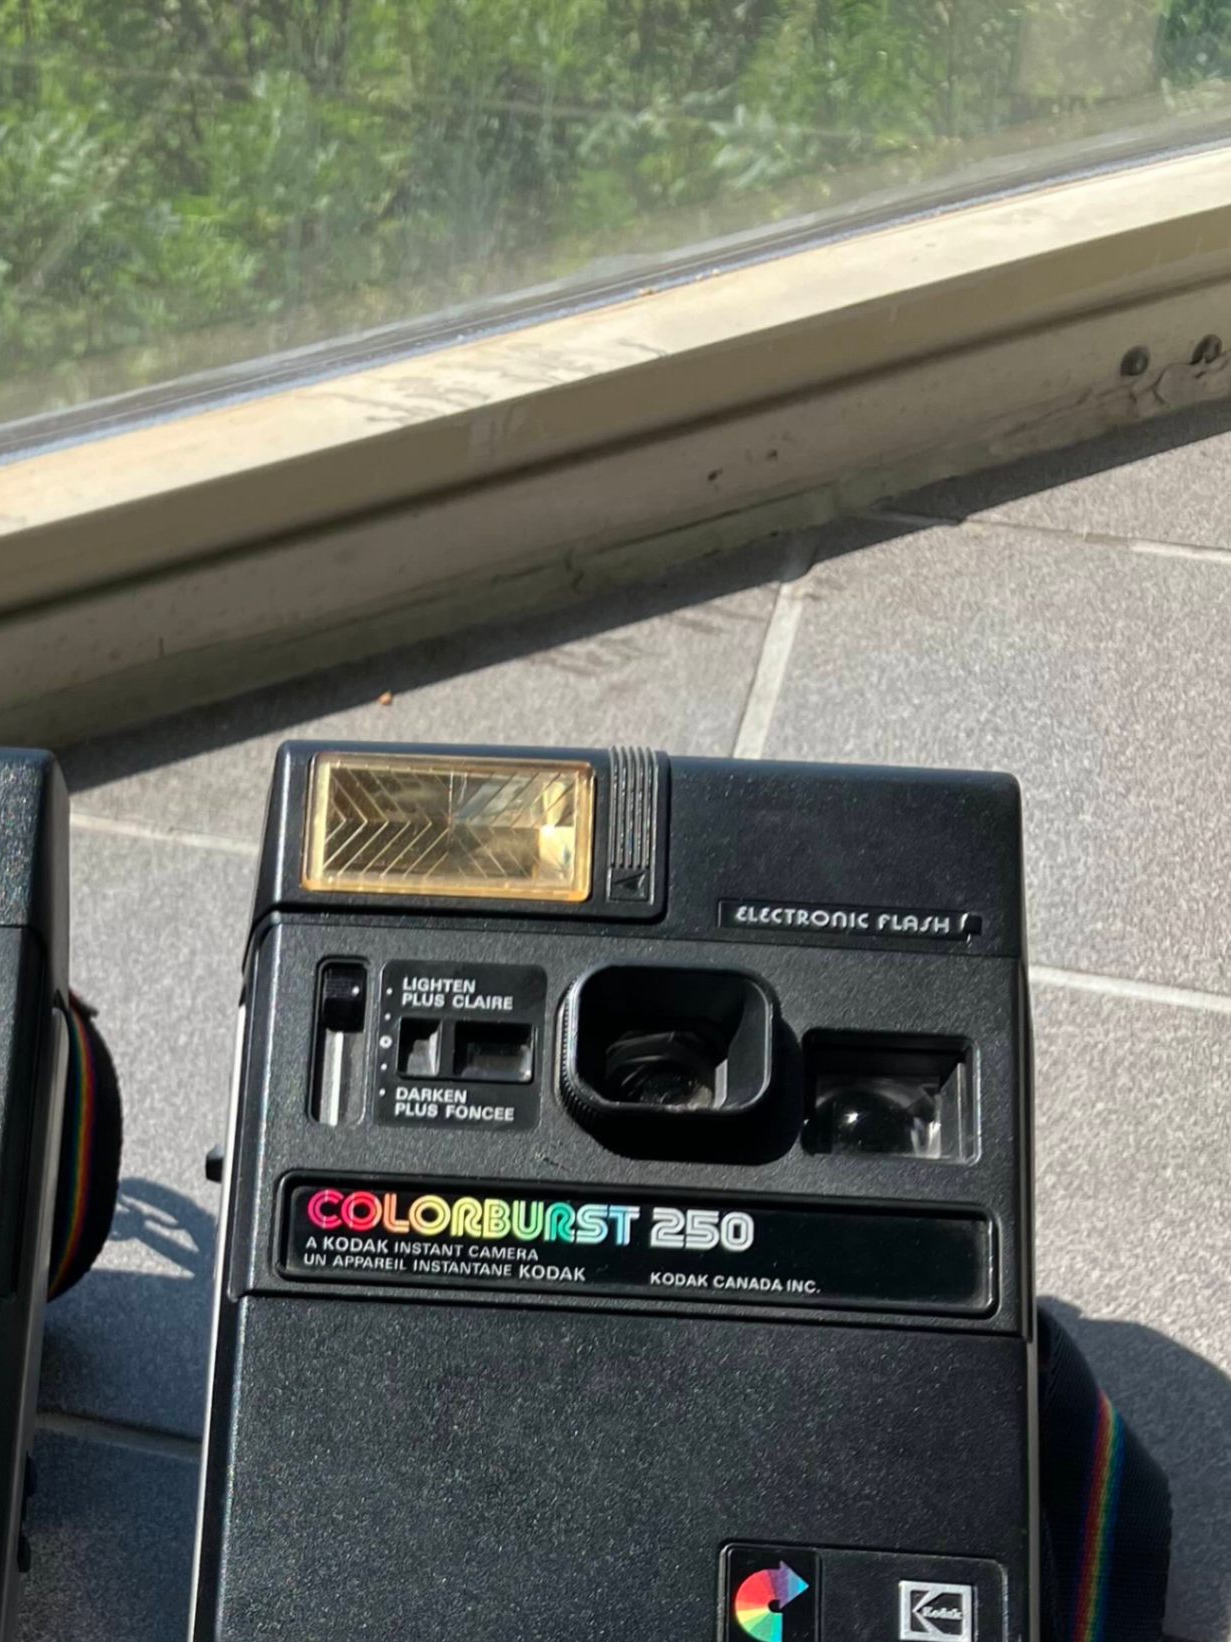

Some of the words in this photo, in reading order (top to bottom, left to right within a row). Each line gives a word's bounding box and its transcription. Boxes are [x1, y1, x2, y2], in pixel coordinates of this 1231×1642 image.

[735, 906, 869, 929] ELECTRONIC
[878, 913, 950, 933] FLASH
[402, 977, 476, 994] LIGHTEN
[401, 992, 445, 1008] PLUS
[452, 995, 514, 1011] CLAIRE
[395, 1086, 468, 1104] DARKEN
[394, 1102, 438, 1118] PLUS
[445, 1105, 515, 1121] FONCEE
[307, 1189, 641, 1246] COLORBURST
[649, 1206, 755, 1252] 250
[305, 1236, 317, 1249] A
[323, 1235, 389, 1254] KODAK
[394, 1241, 464, 1258] INSTANT
[468, 1245, 539, 1262] CAMERA
[303, 1253, 326, 1267] UN
[332, 1254, 407, 1272] APPAREIL
[413, 1259, 512, 1278] INSTANTANE
[519, 1264, 587, 1282] KODAK
[650, 1271, 708, 1288] KODAK
[713, 1275, 783, 1292] CANADA
[786, 1280, 821, 1294] INC.
